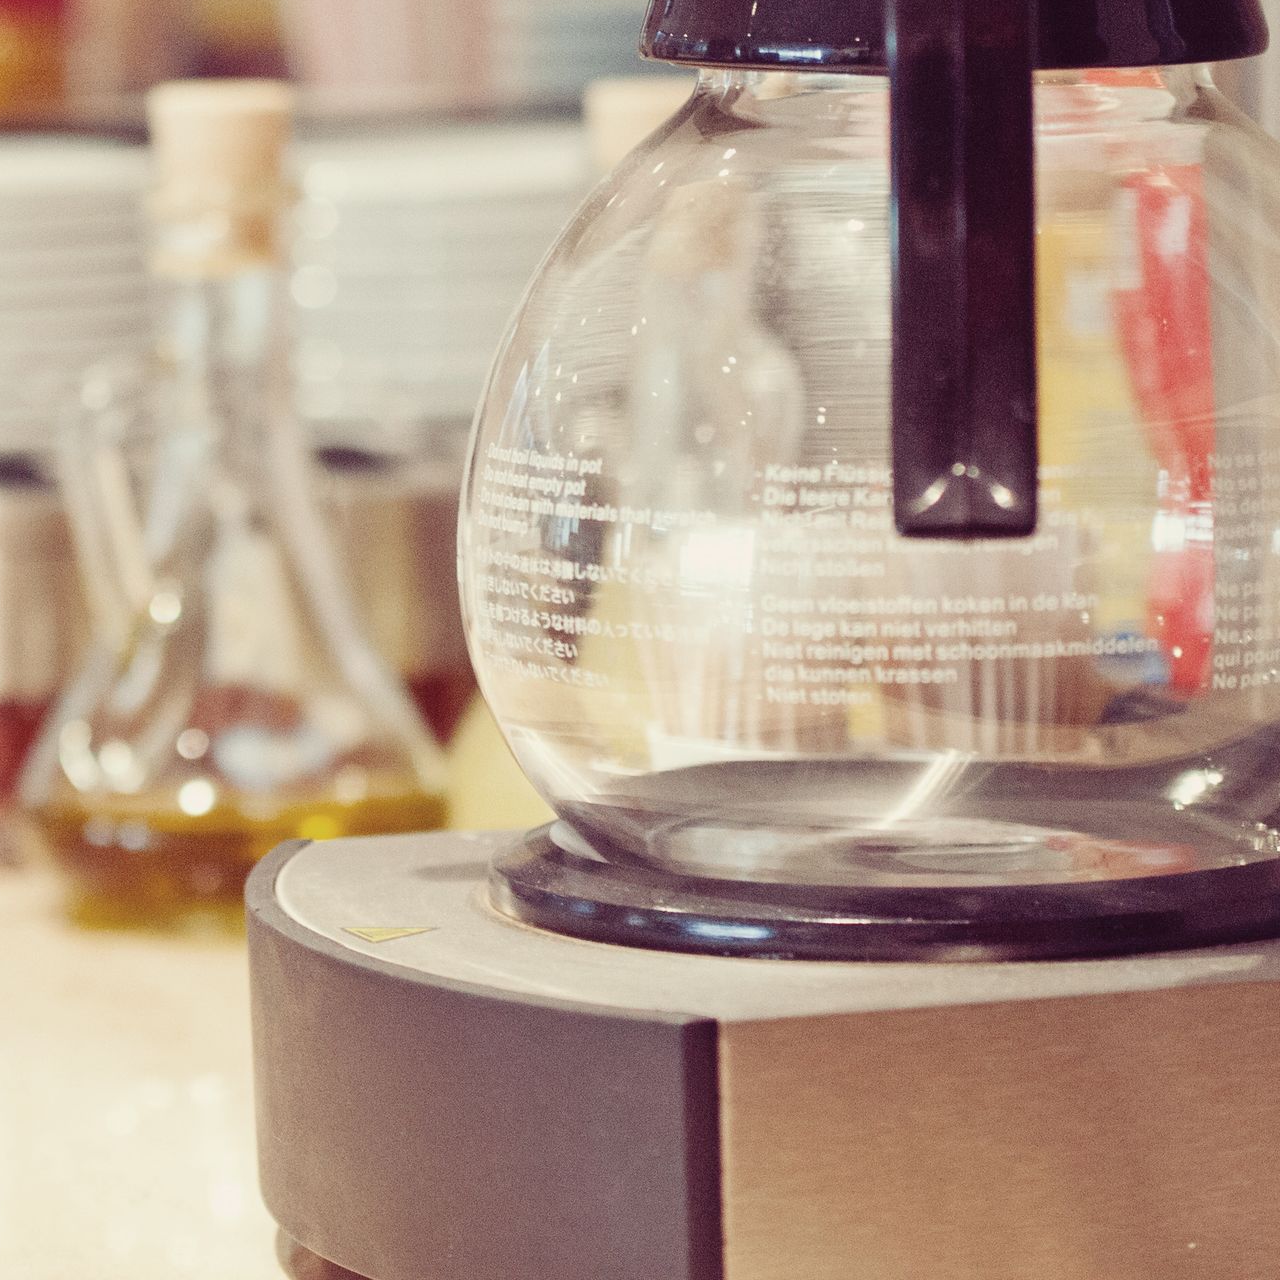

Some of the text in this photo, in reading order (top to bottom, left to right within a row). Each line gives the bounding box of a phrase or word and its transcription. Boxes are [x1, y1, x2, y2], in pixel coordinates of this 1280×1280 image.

[566, 455, 578, 472] in
[578, 458, 602, 477] pot
[765, 464, 821, 483] Keine
[529, 475, 564, 498] empty
[564, 479, 586, 499] pot
[763, 486, 797, 506] Die
[555, 501, 618, 523] materials
[941, 593, 1005, 612] koken
[1008, 593, 1028, 611] in
[1032, 592, 1058, 610] de
[761, 617, 1017, 641] De lege kan niet verhitten
[805, 642, 889, 664] reinigen
[892, 643, 932, 661] met
[934, 637, 1159, 661] schoonmaakmiddelen
[764, 664, 957, 684] die kunnen krassen
[766, 686, 807, 704] Niet
